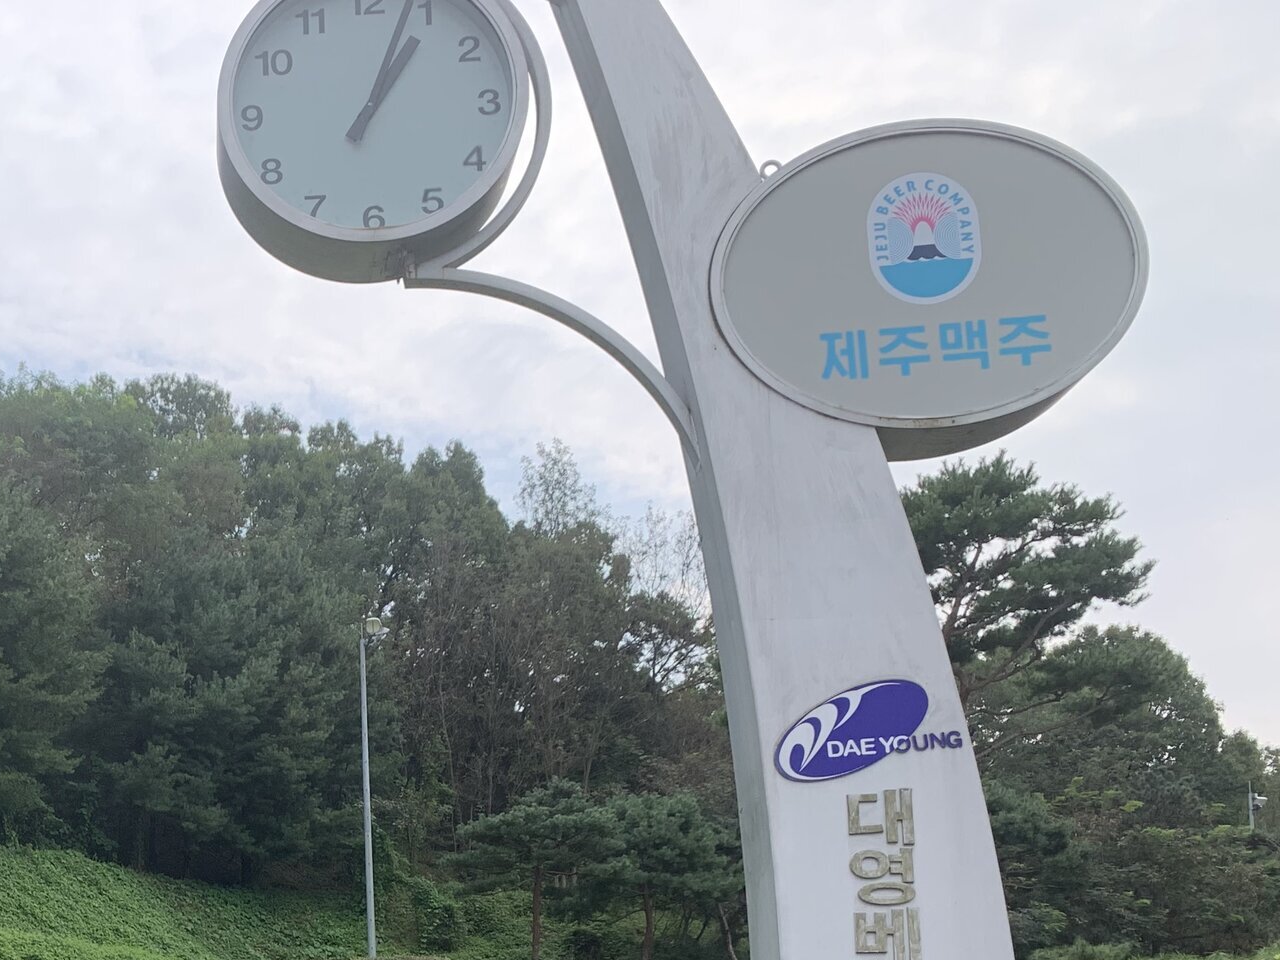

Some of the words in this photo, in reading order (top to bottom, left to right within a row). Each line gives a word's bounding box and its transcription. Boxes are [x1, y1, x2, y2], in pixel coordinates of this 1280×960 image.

[295, 8, 326, 35] 11
[417, 0, 433, 26] 1
[254, 50, 293, 76] 10
[458, 36, 482, 63] 2
[477, 89, 502, 116] 3
[240, 105, 264, 131] 9
[261, 158, 283, 185] 8
[463, 145, 487, 172] 4
[303, 194, 327, 218] 7
[421, 188, 445, 215] 5
[876, 180, 917, 215] BEER
[363, 205, 386, 229] 6
[924, 179, 975, 253] COMPANY
[874, 222, 889, 261] JEJU
[820, 314, 1052, 379] 제주맥주
